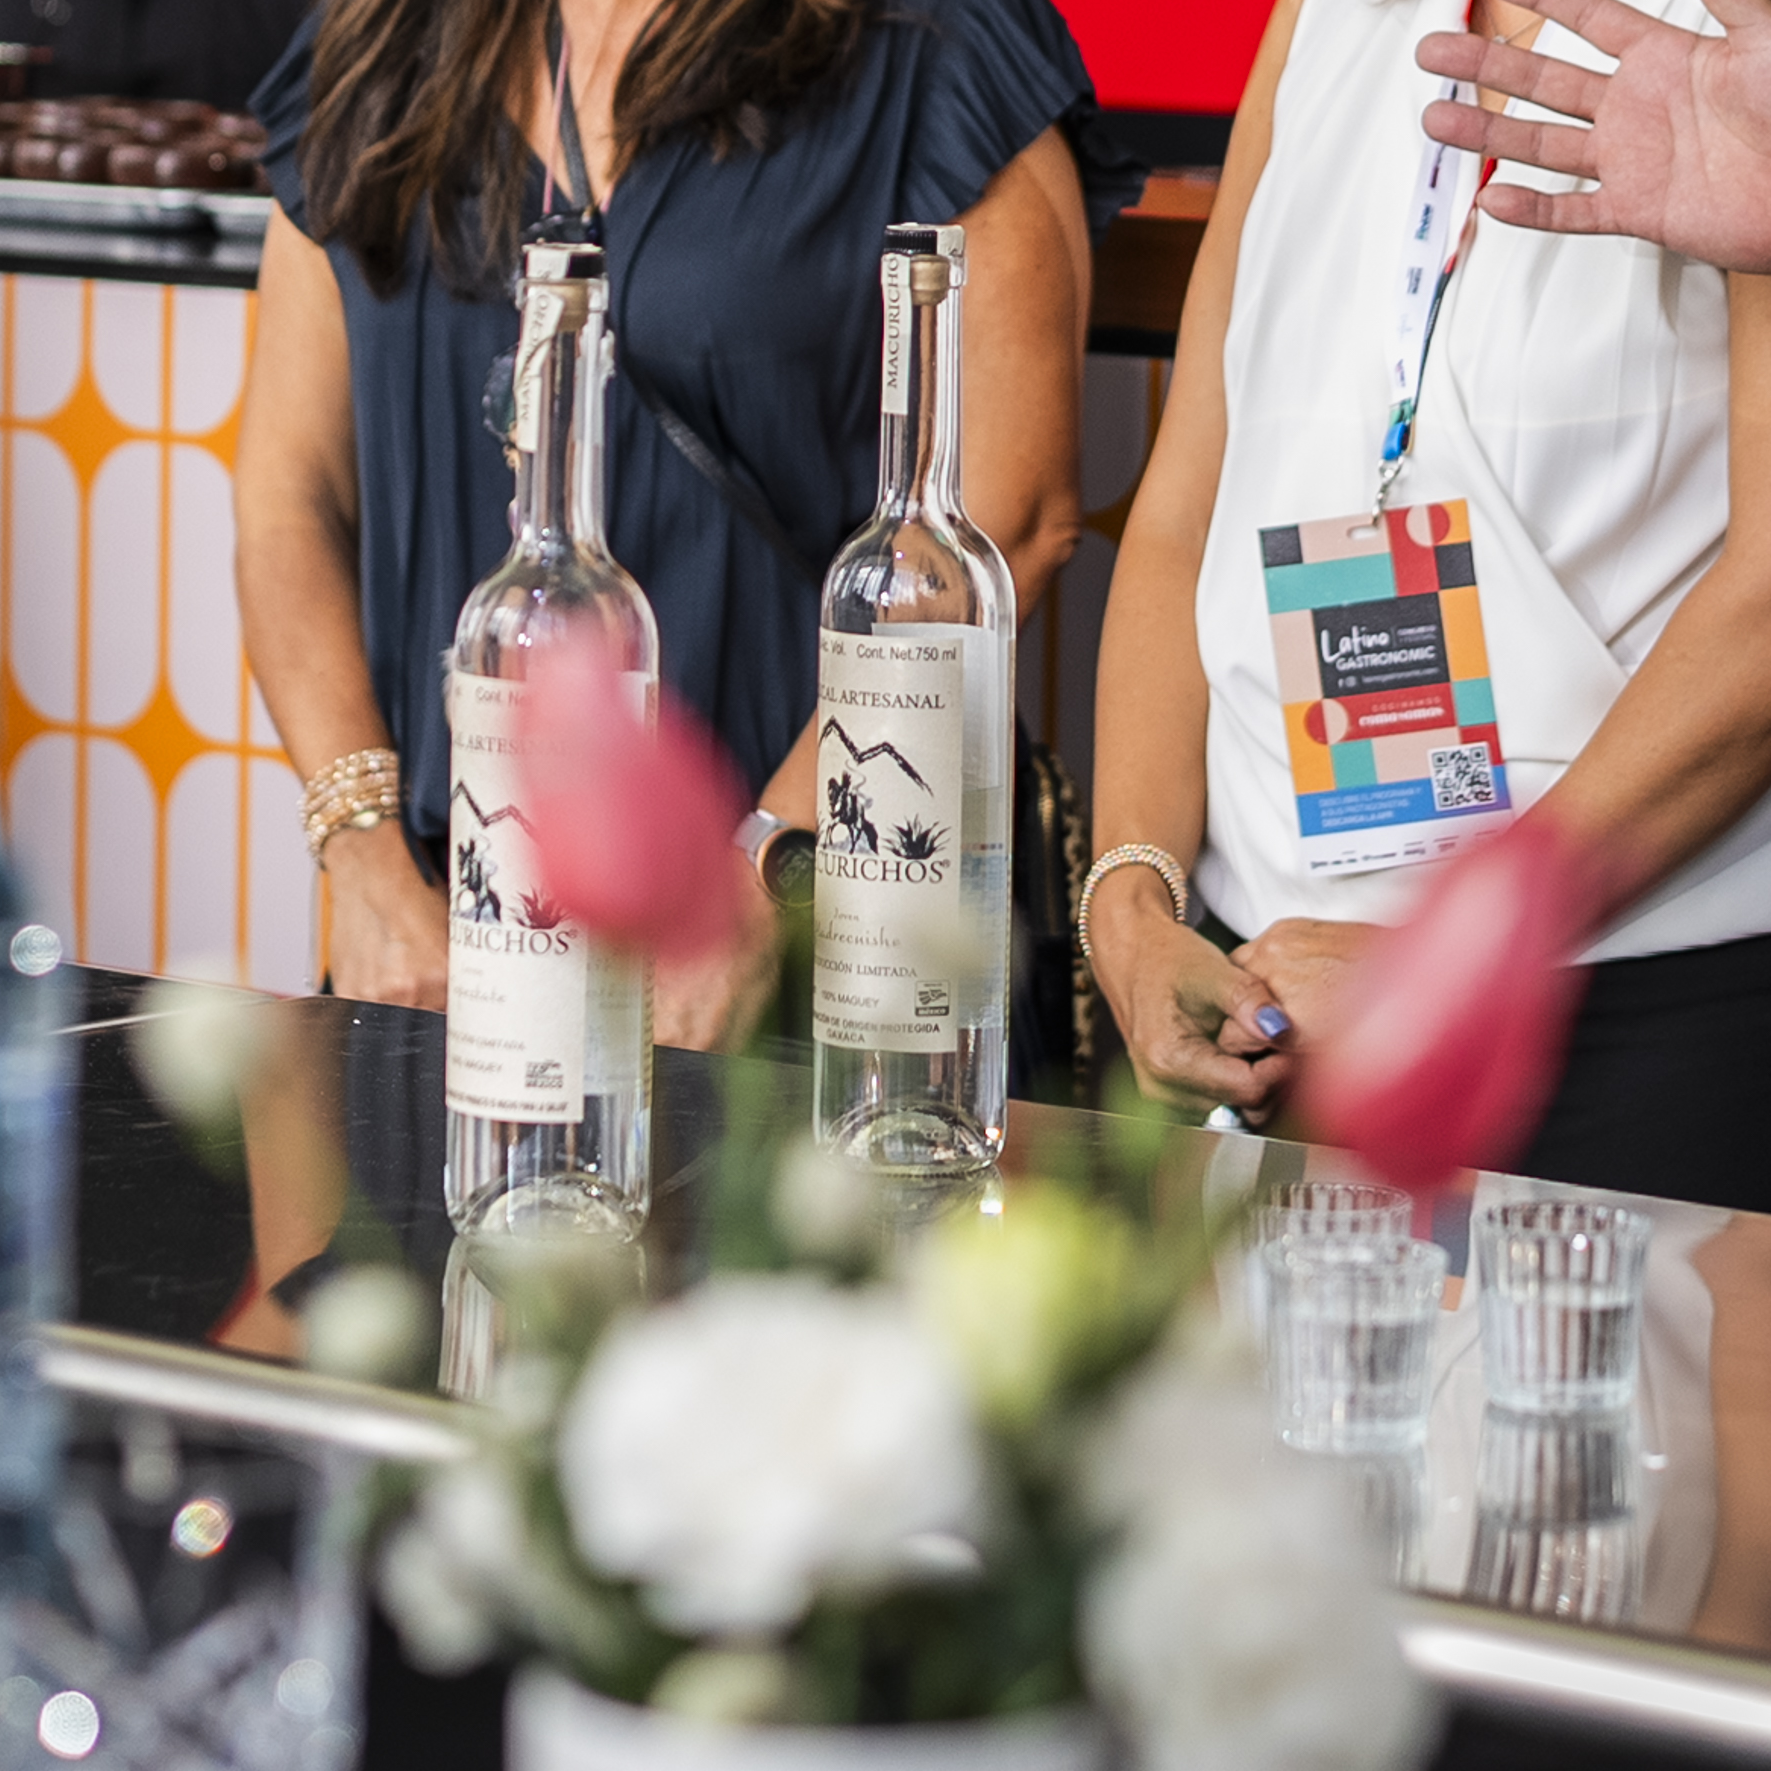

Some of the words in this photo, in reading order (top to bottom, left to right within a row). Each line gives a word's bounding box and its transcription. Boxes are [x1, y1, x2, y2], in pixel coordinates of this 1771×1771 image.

[886, 257, 899, 389] MACURICHO
[1320, 625, 1390, 664] Latino
[942, 647, 957, 660] ml
[1335, 645, 1436, 671] GASTRONOMIC
[839, 689, 946, 709] ARTESANAL
[857, 964, 918, 978] LIMITADA
[838, 993, 880, 1008] MAGUEY
[880, 1023, 941, 1033] PROTEGIDA
